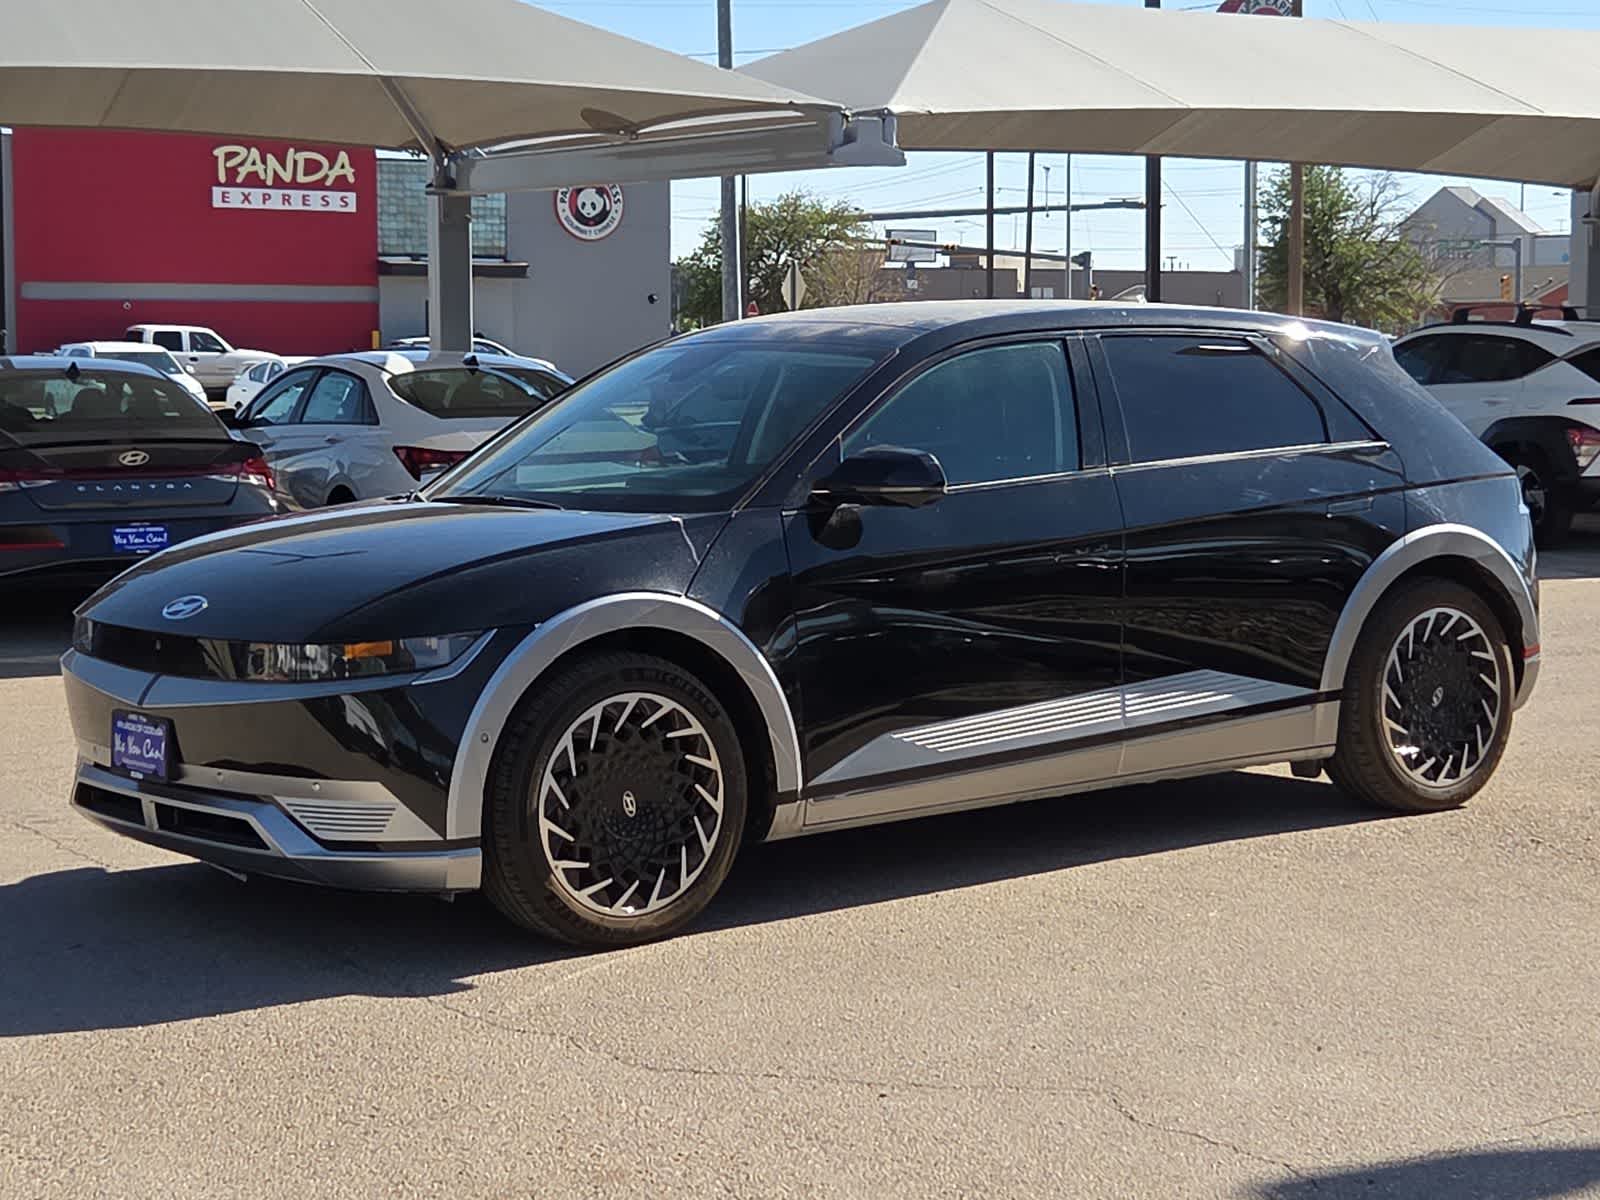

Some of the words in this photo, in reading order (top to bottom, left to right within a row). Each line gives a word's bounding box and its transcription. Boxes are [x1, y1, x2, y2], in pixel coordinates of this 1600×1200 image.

[212, 144, 356, 187] PANDA
[220, 191, 349, 208] EXPRESS
[77, 482, 192, 492] ELANTRA
[113, 534, 127, 544] Yes
[114, 732, 126, 753] Yes
